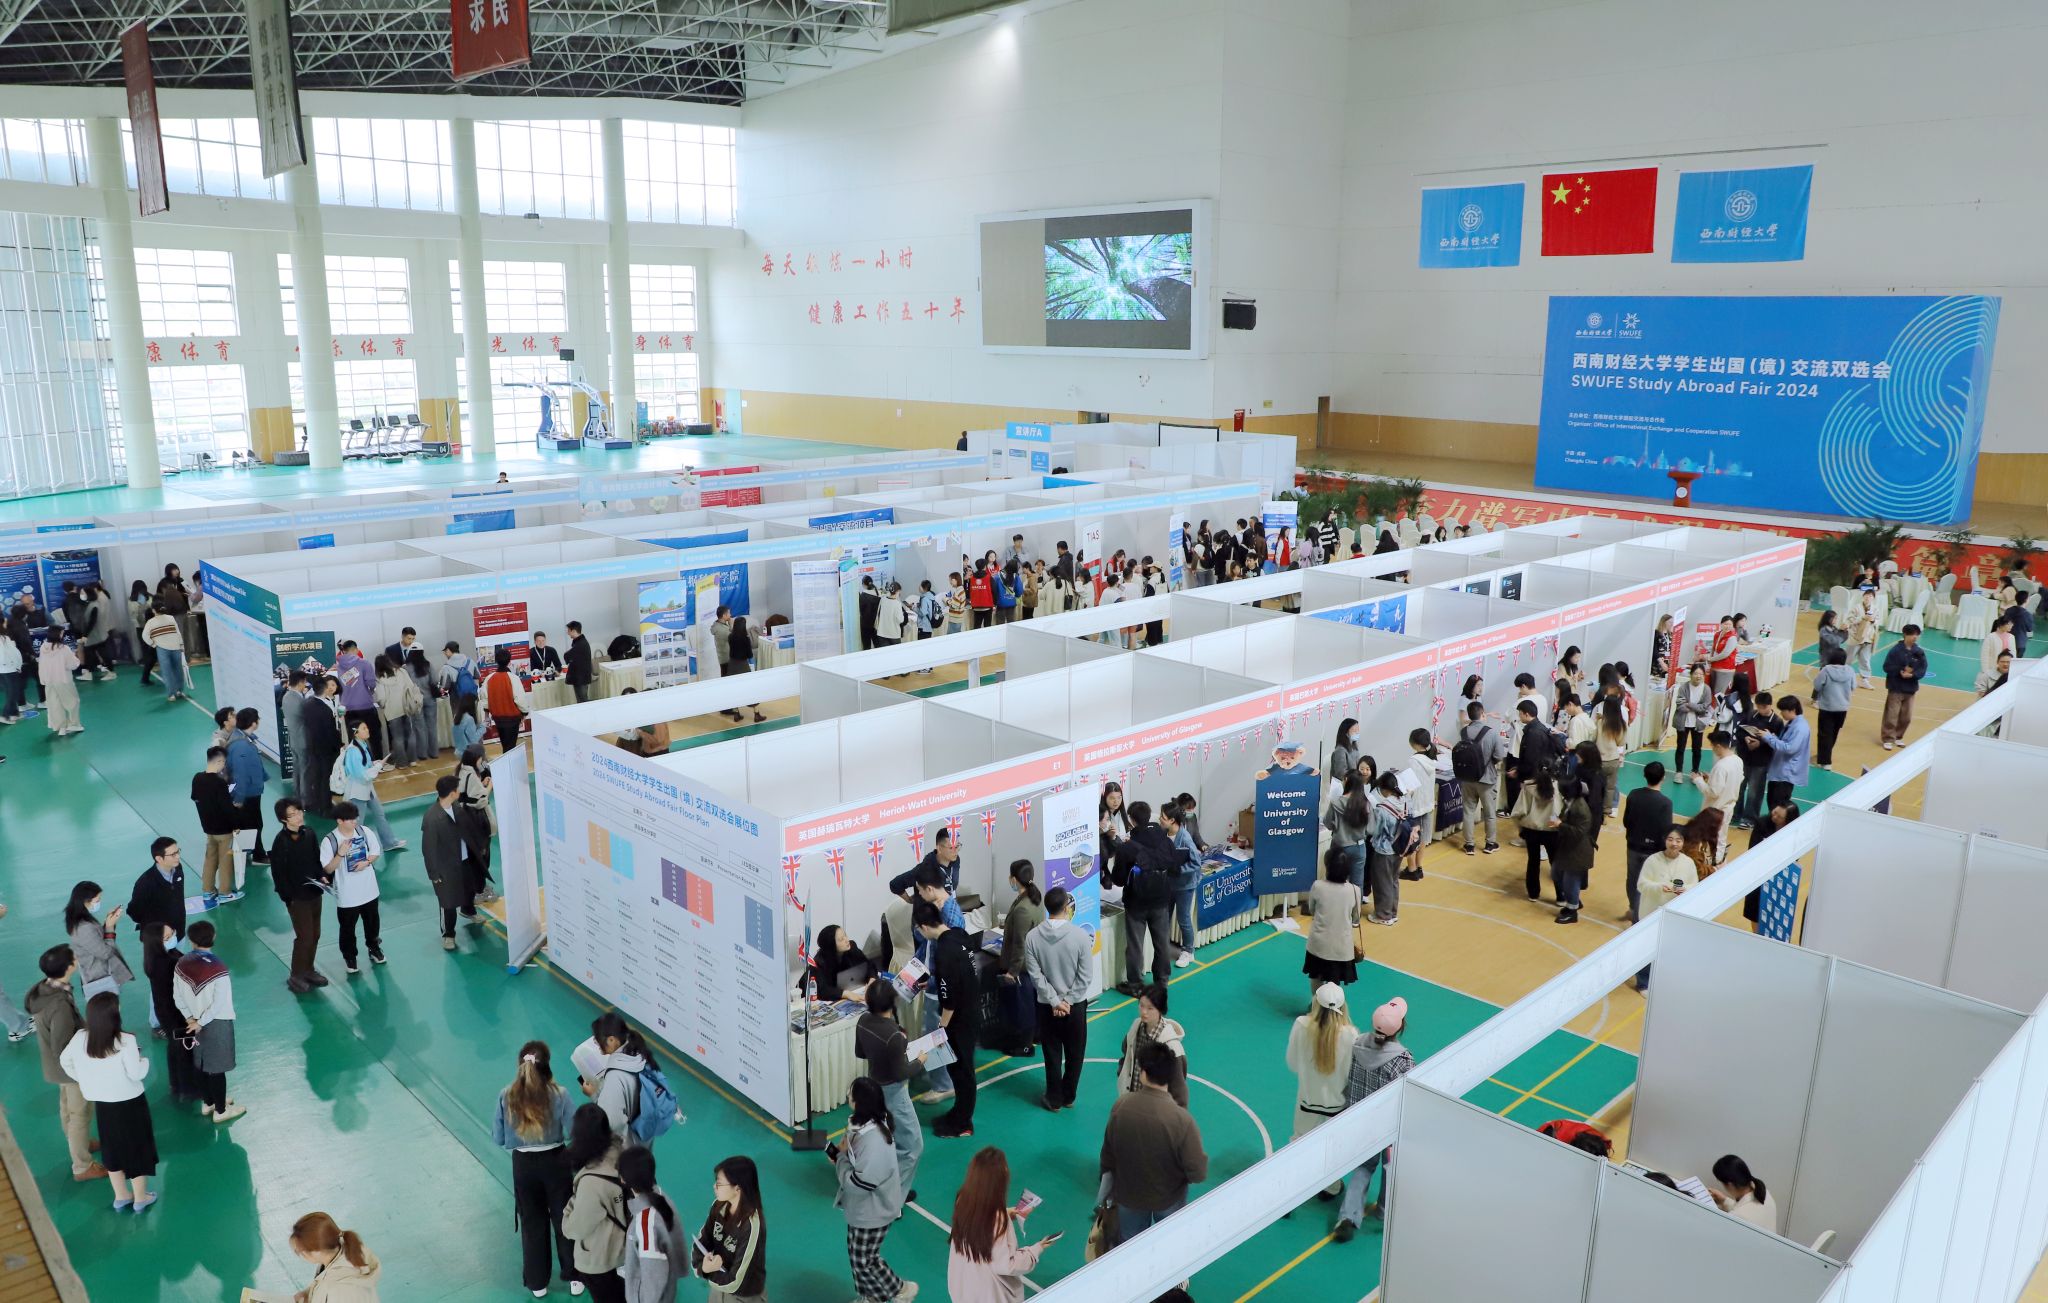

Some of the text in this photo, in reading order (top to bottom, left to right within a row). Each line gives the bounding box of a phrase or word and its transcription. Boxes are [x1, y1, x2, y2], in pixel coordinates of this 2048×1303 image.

[807, 296, 967, 326] 健康工作五十年
[1571, 374, 1819, 398] SWUFE Study Abroad Fair 2024
[1141, 730, 1171, 746] University
[1178, 721, 1203, 737] Glasgow
[592, 767, 711, 828] 2024 SWUFE Study Abroad Fair Floor Plan
[879, 761, 1062, 819] Heriot-Watt University E1
[1266, 790, 1307, 800] Welcome
[1263, 807, 1309, 818] University
[1281, 800, 1291, 808] to
[1280, 817, 1291, 826] of
[1065, 824, 1089, 838] GLOBAL
[1267, 827, 1305, 837] Glasgow
[1049, 831, 1094, 853] OUR CAMPUSES
